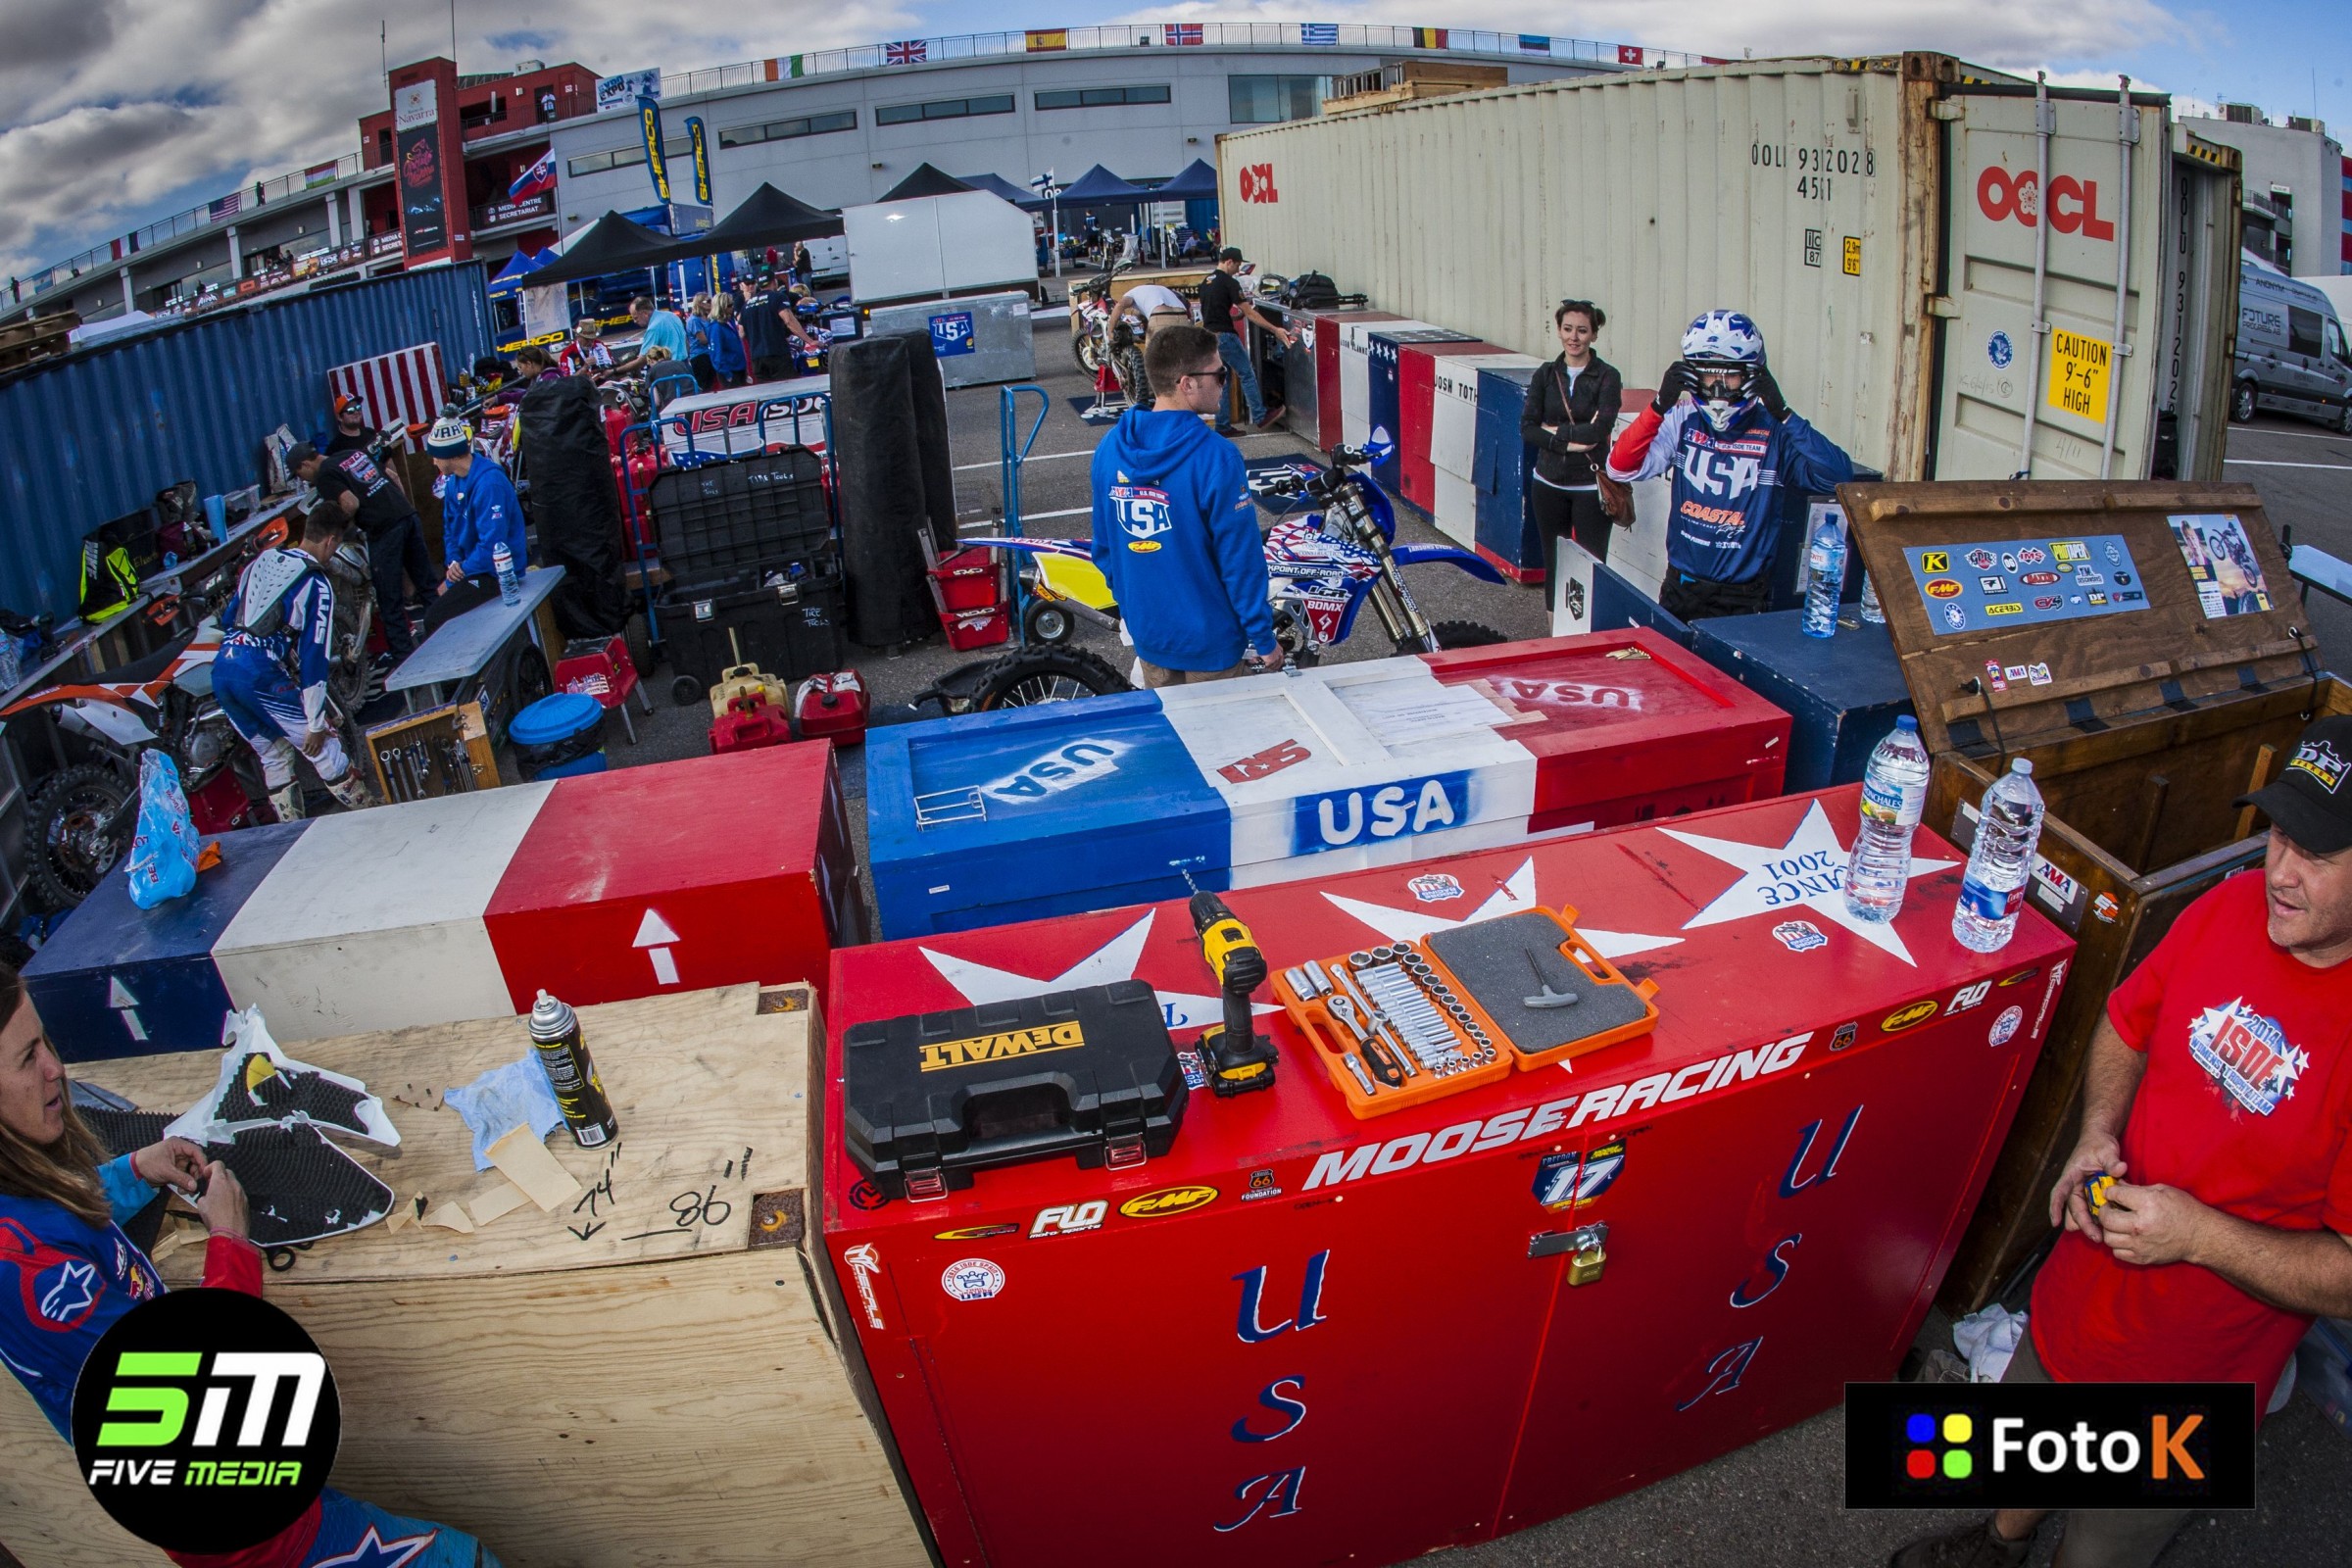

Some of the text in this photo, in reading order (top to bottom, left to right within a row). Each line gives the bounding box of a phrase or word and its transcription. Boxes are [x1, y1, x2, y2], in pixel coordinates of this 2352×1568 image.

[644, 108, 671, 199] SHERCO
[499, 206, 540, 220] SECRETARIAT
[1978, 166, 2114, 242] OOCL
[1809, 251, 1820, 263] 87
[496, 330, 564, 353] HERCO
[2055, 332, 2108, 368] CAUTION
[1434, 373, 1453, 394] JOSH
[2062, 386, 2091, 416] HIGH
[673, 400, 759, 436] USA
[1684, 428, 1715, 450] AMA
[1684, 444, 1761, 500] USA
[1109, 497, 1173, 539] USA
[1010, 537, 1053, 546] KENDA
[1927, 554, 1945, 571] K
[2020, 552, 2043, 561] IMS
[1267, 564, 1345, 577] KPOINT OFF-ROAD
[1308, 585, 1349, 597] LCR
[1928, 583, 1961, 594] FMF
[316, 579, 333, 644] ALIAS
[1307, 601, 1345, 612] BDMX
[1988, 605, 2022, 615] ACERBIS
[1512, 680, 1630, 709] USA
[992, 742, 1116, 800] USA
[2294, 747, 2342, 773] DP
[1318, 779, 1456, 846] USA
[1762, 850, 1836, 882] 2001
[2036, 861, 2072, 894] AMA
[1757, 865, 1848, 906] ANCE
[1947, 979, 1993, 1011] FLO
[1886, 1004, 1936, 1027] FMF
[1834, 1034, 1851, 1049] 66
[2247, 1014, 2280, 1046] 2014
[919, 1022, 1085, 1072] DEWALT
[2190, 1036, 2223, 1070] WOMENS
[2209, 1013, 2285, 1092] ISDE
[1253, 1177, 1271, 1188] 66
[1542, 1154, 1624, 1206] 17
[1124, 1189, 1214, 1215] FMF
[1241, 1188, 1282, 1200] FOUNDATION
[1029, 1200, 1108, 1235] FLO
[1029, 1230, 1057, 1239] moto
[1061, 1224, 1102, 1235] sports
[960, 1260, 978, 1269] ISDE
[979, 1260, 999, 1275] SPAIN
[855, 1263, 885, 1330] DECALS
[960, 1291, 994, 1300] USA
